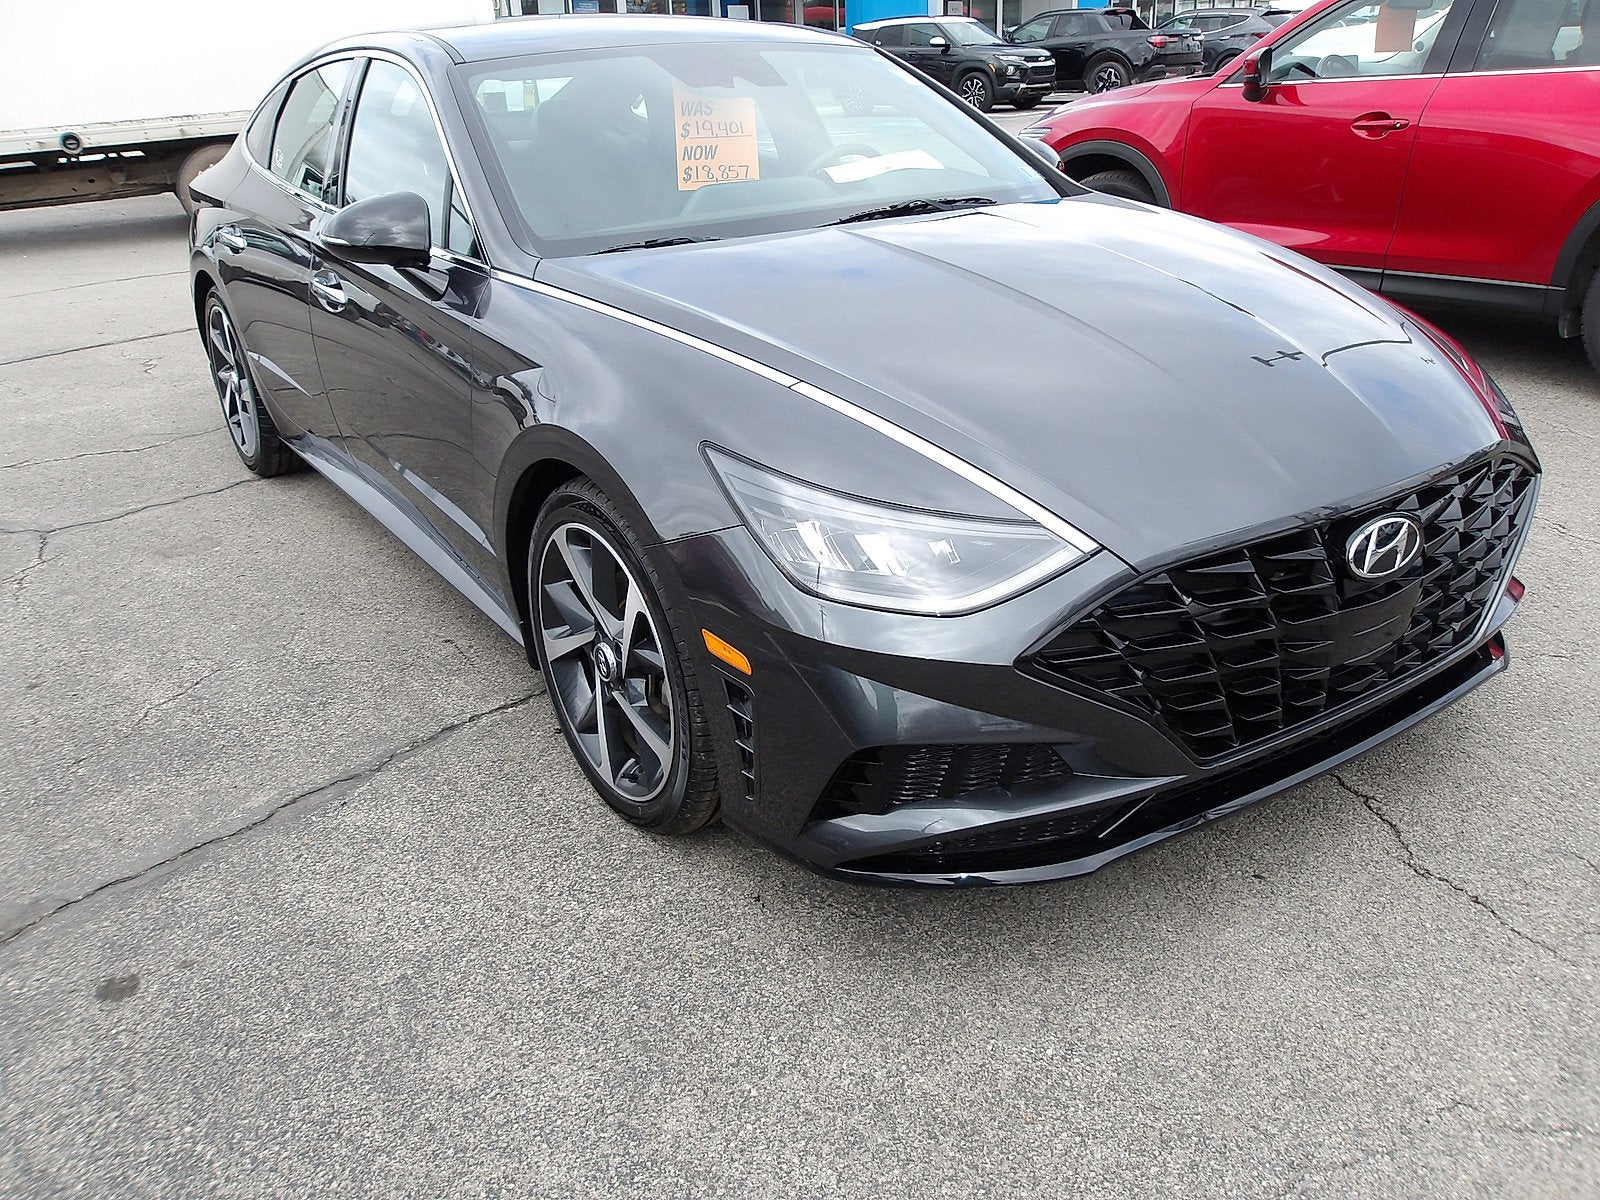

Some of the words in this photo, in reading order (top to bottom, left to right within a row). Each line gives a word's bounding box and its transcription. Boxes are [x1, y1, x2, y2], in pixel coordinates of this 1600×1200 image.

[680, 100, 714, 117] WAS
[680, 119, 744, 140] $19,401
[682, 144, 719, 161] NOW
[682, 164, 750, 183] $18,857
